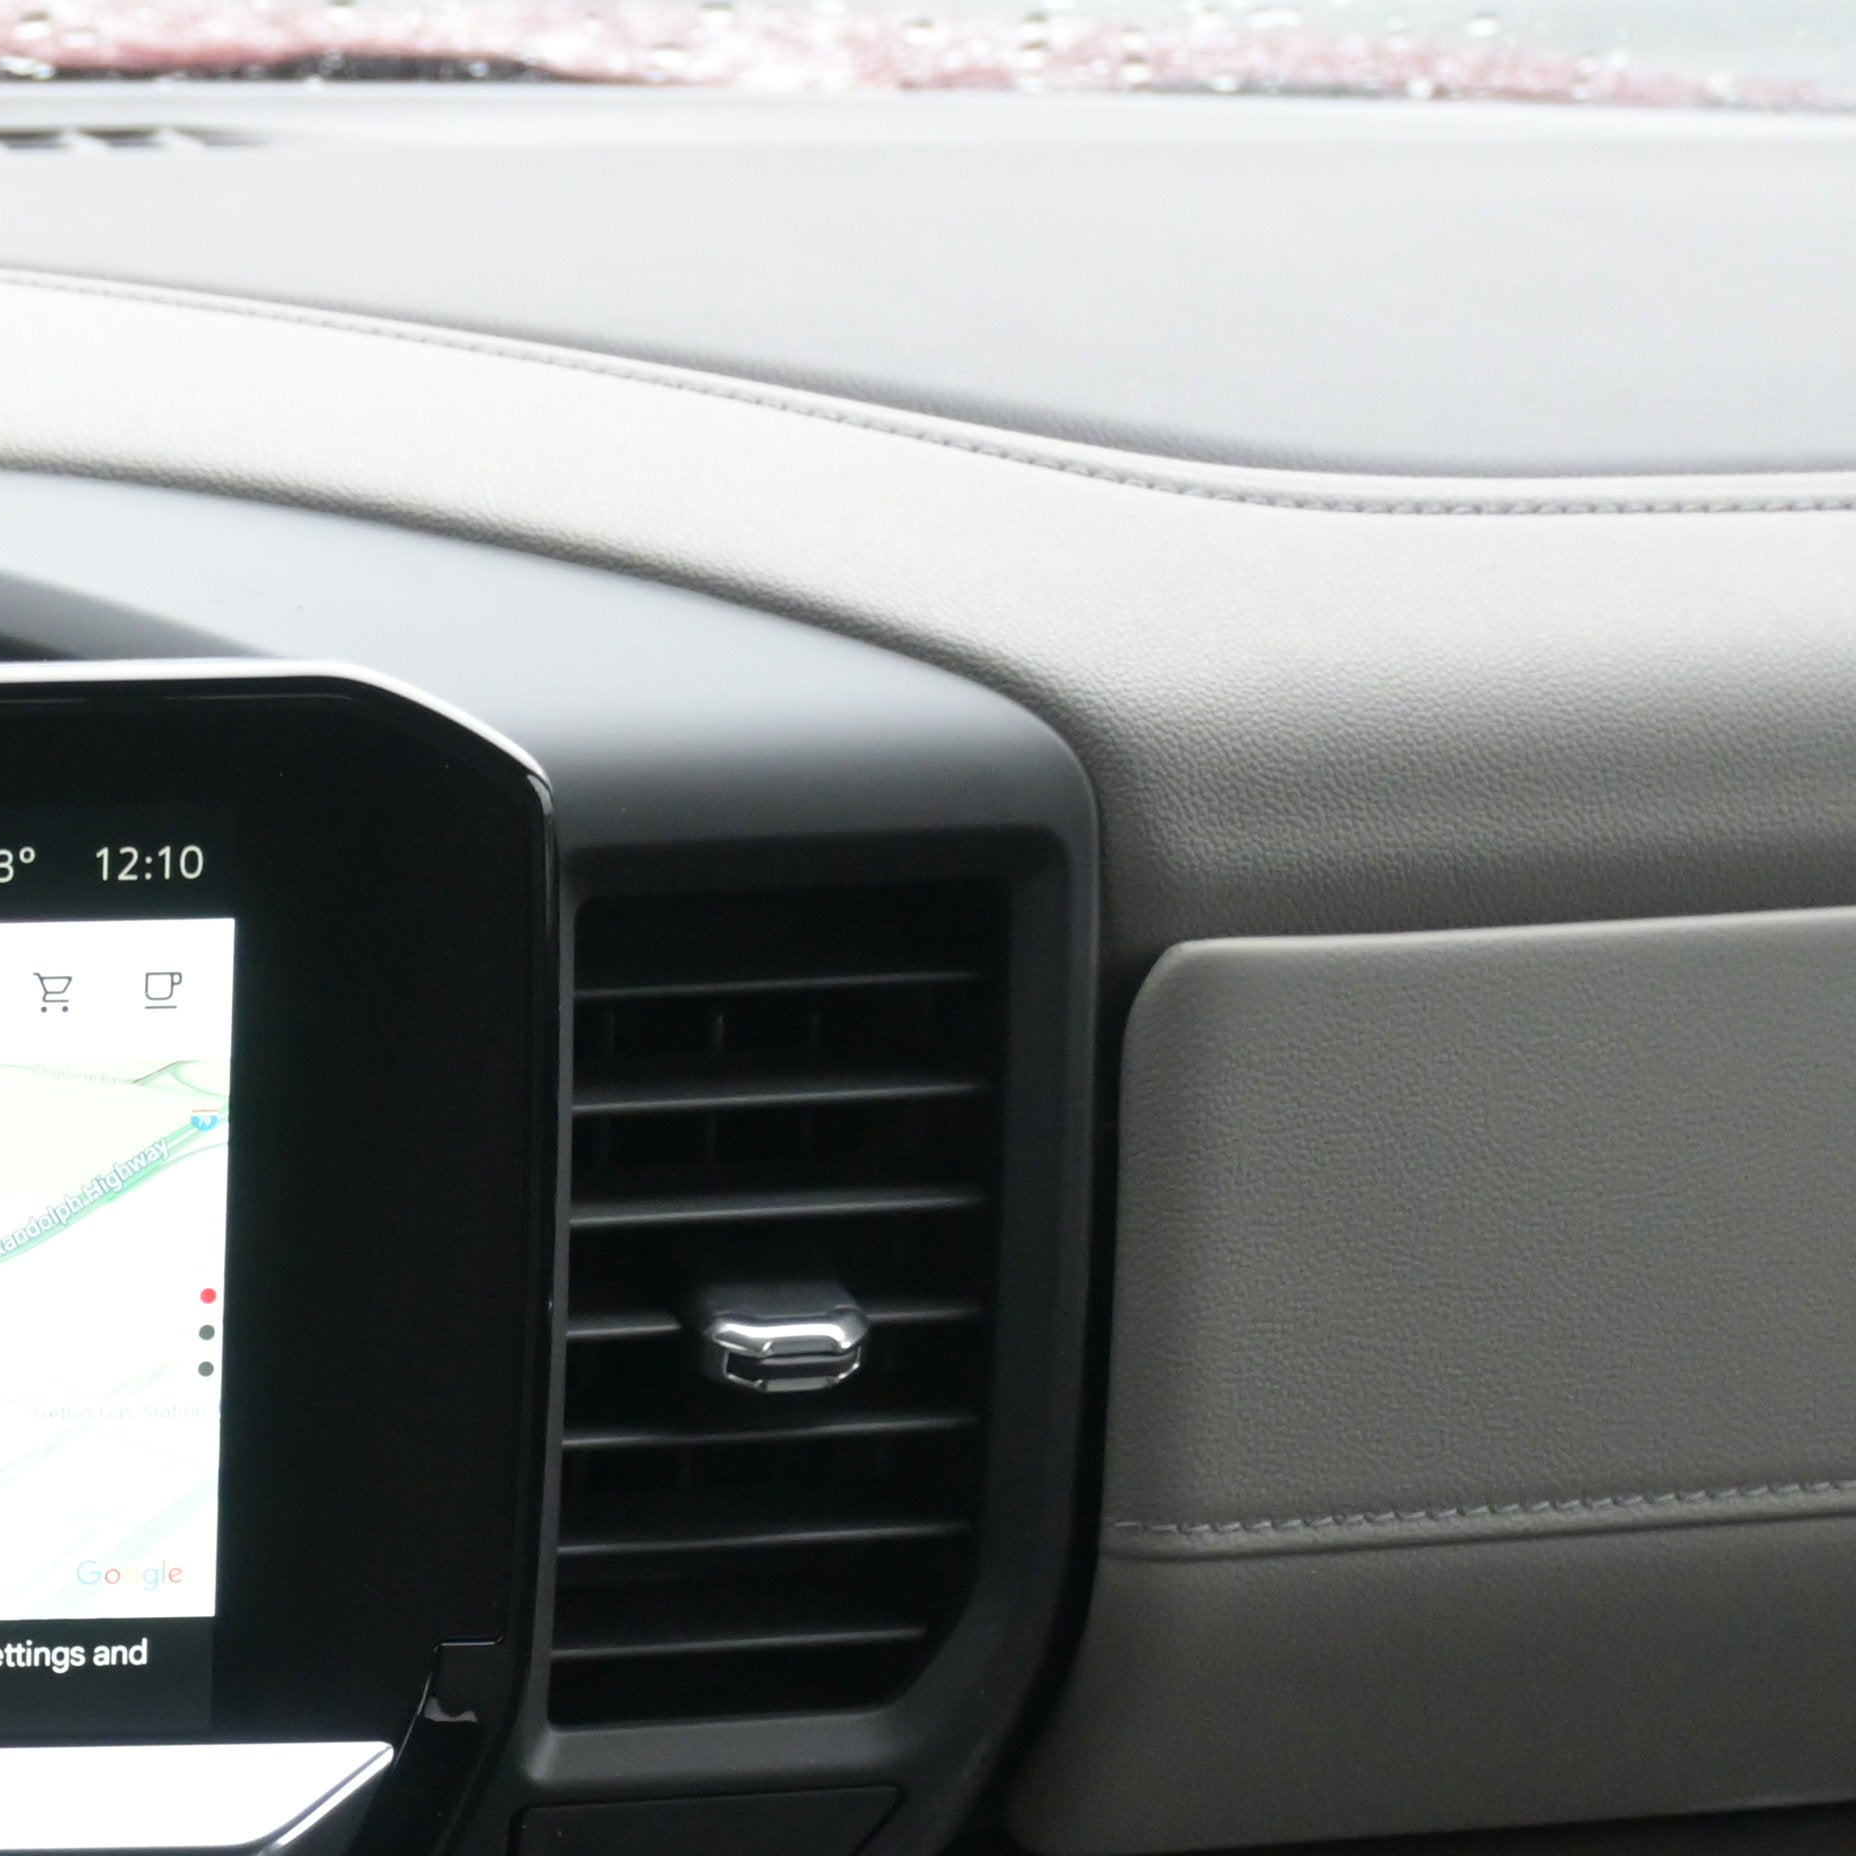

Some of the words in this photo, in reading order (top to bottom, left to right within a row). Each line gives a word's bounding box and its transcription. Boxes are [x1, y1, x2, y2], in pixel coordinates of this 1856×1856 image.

[96, 845, 203, 881] 12:10
[84, 1138, 169, 1204] Highway
[93, 1638, 148, 1666] and
